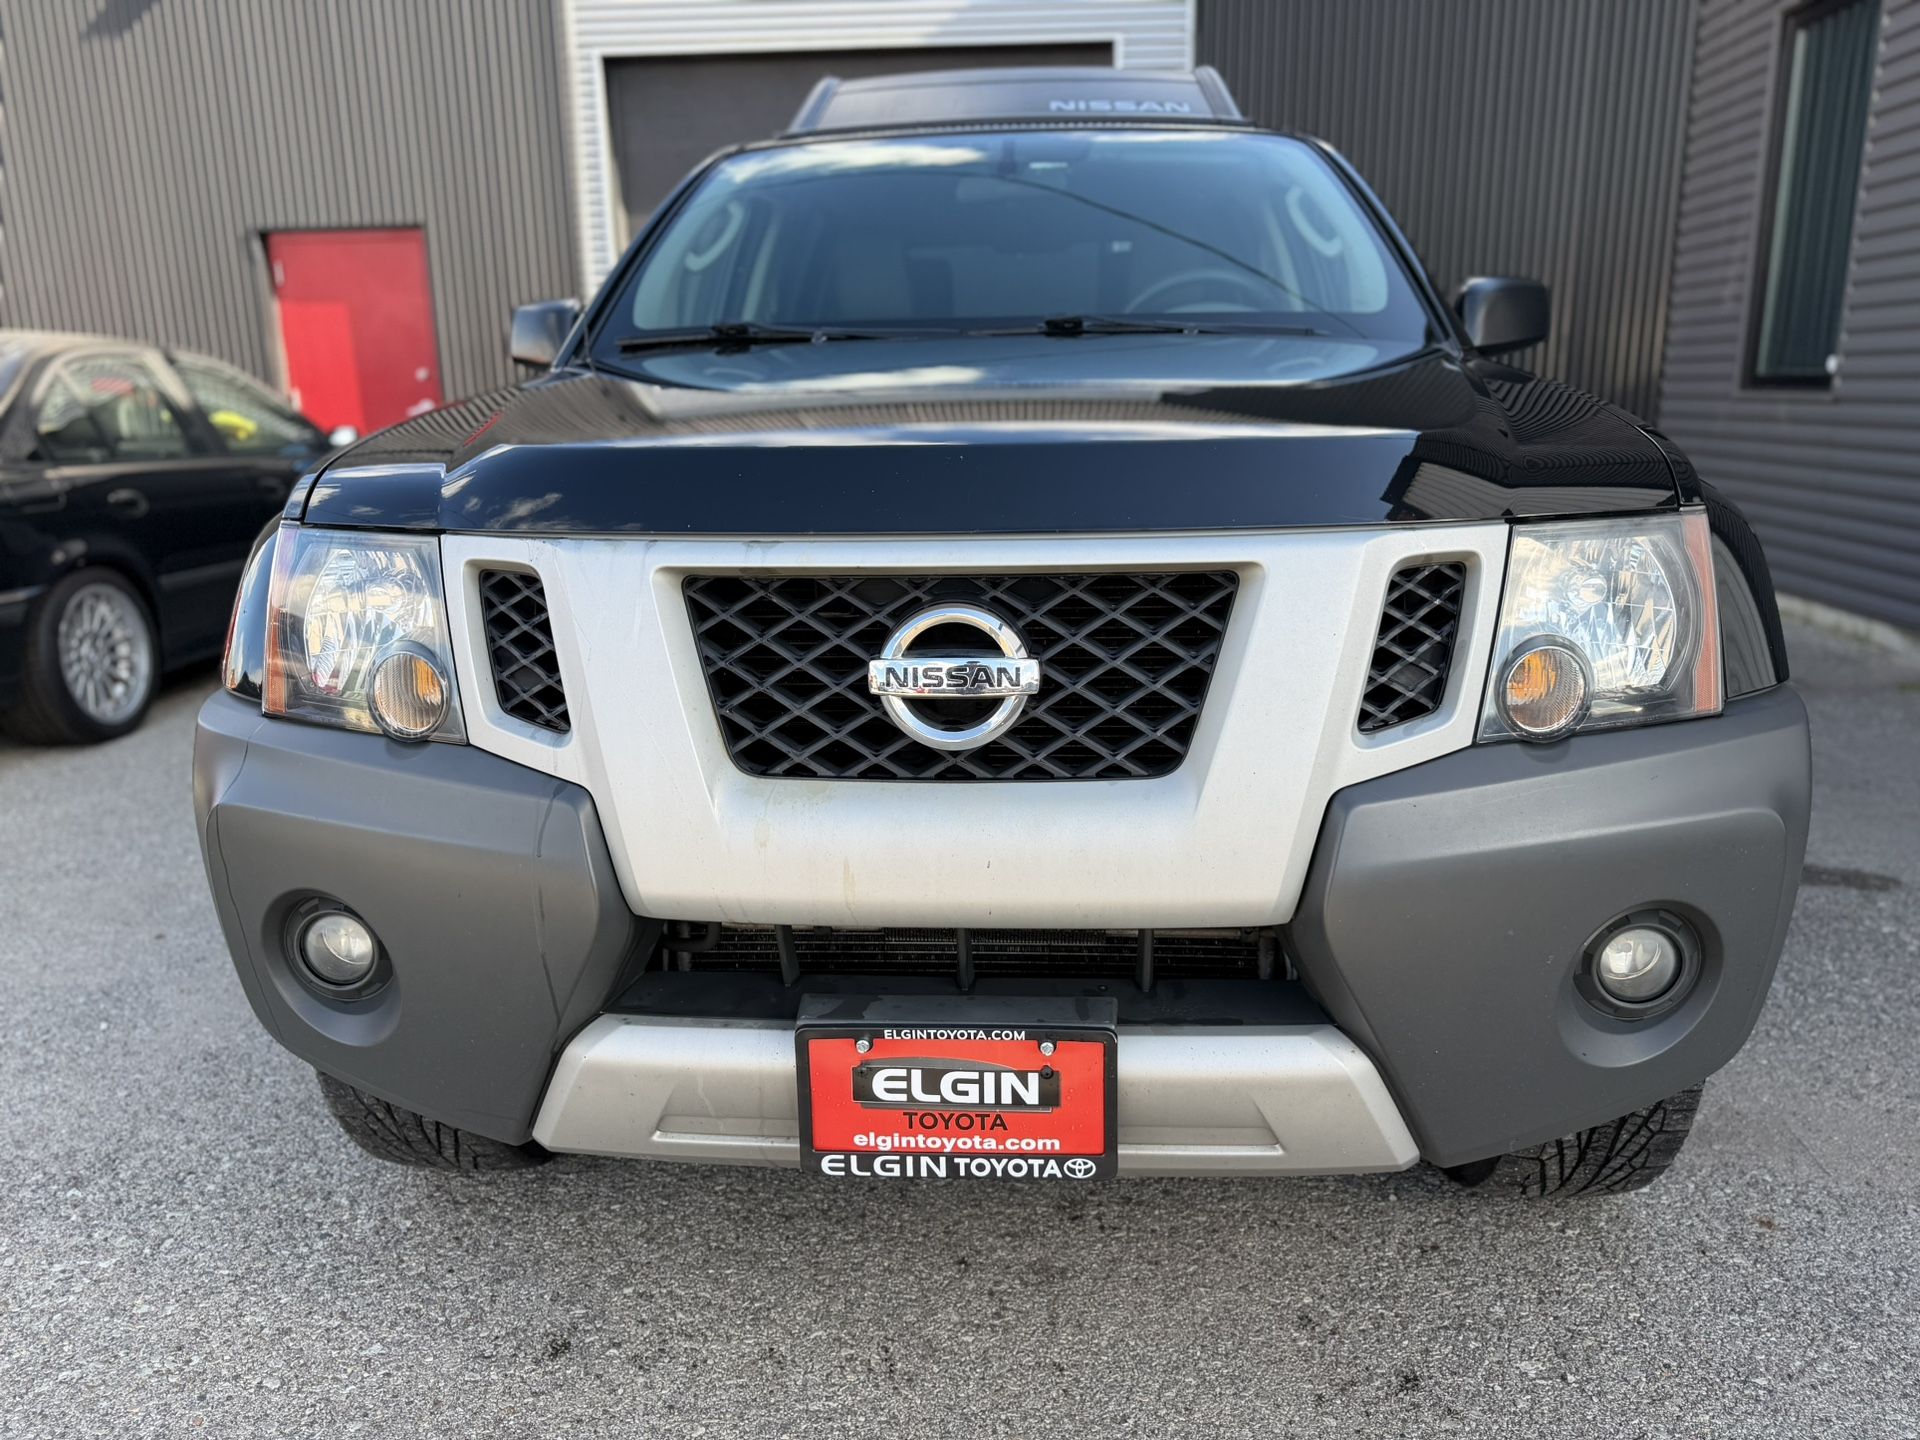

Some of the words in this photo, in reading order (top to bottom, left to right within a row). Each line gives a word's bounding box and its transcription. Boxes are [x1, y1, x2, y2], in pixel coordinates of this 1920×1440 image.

[1049, 100, 1191, 113] NISSAN
[886, 667, 1020, 688] NISSAN
[883, 1029, 1026, 1041] ELGINTOYOTA.COM
[872, 1068, 1039, 1105] ELGIN
[903, 1112, 1008, 1131] TOYOTA
[853, 1132, 1060, 1152] elgintoyota.com
[820, 1154, 947, 1178] ELGIN
[954, 1157, 1062, 1179] TOYOTA
